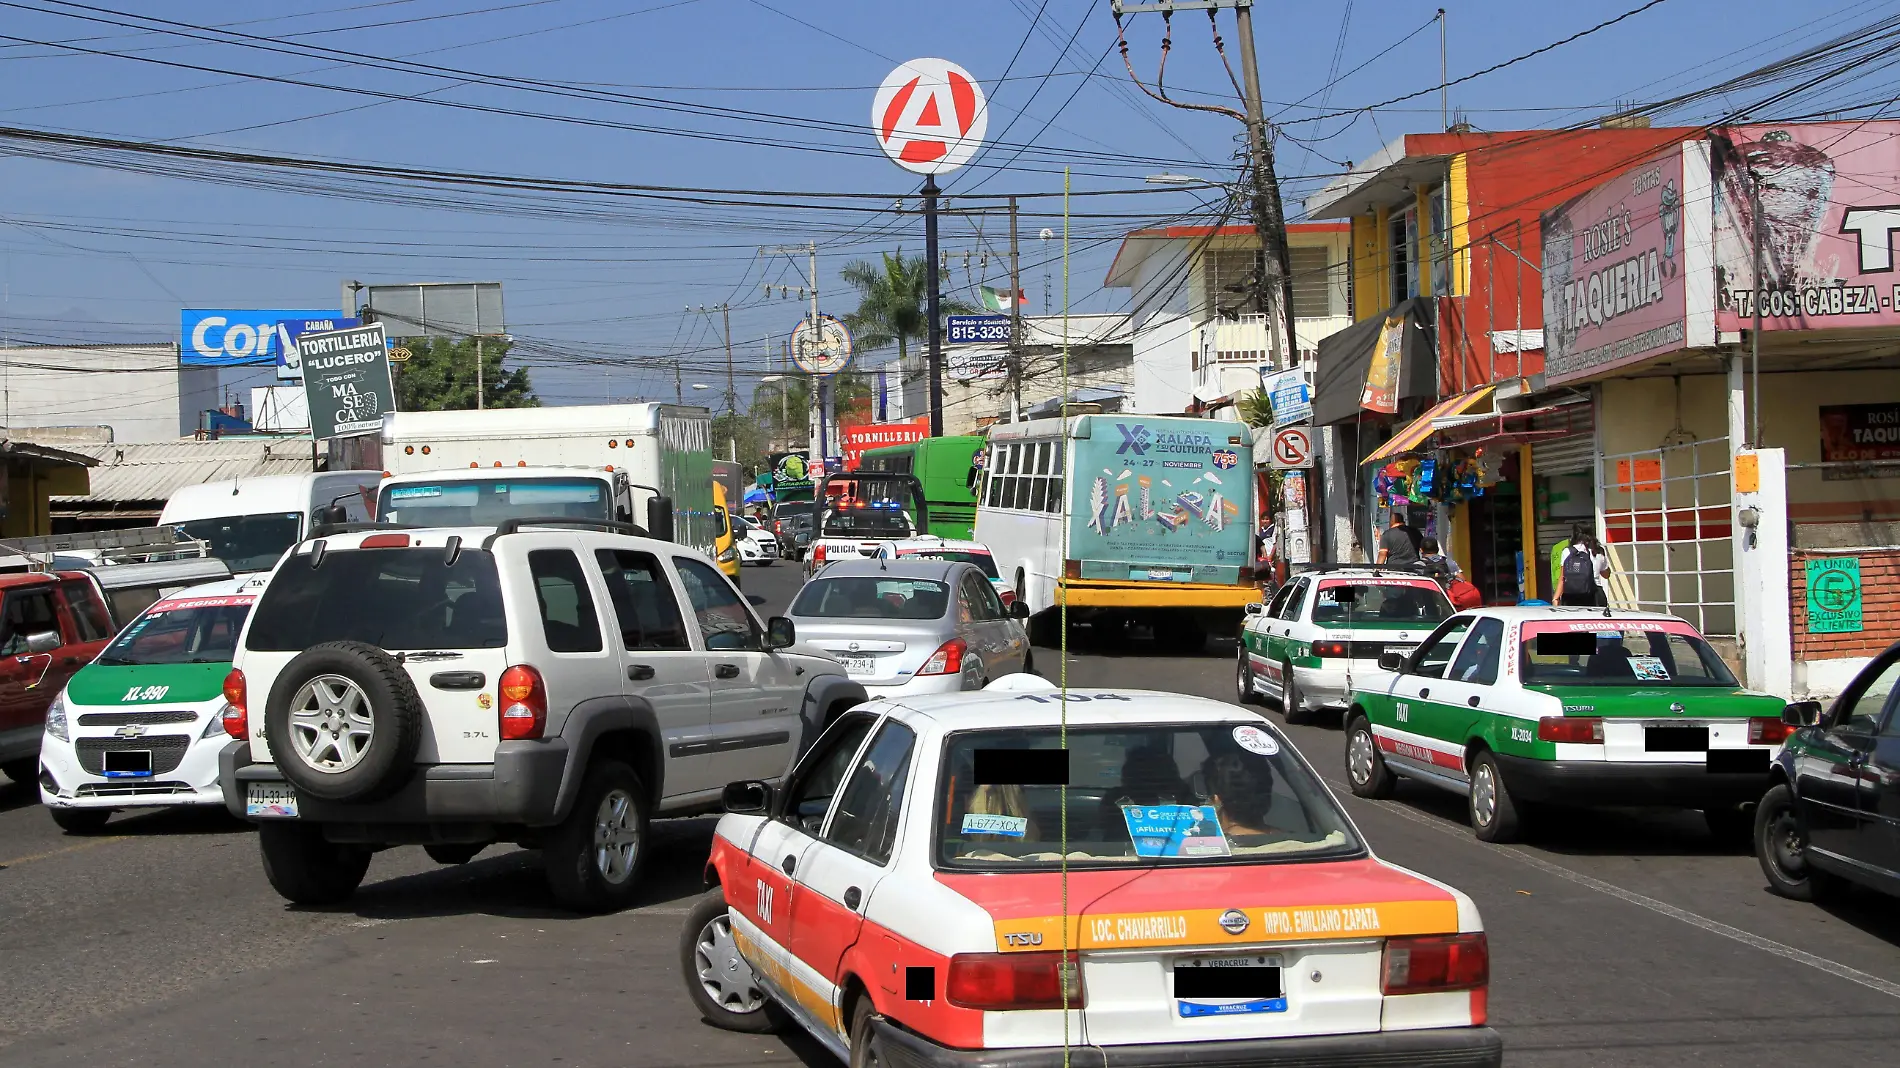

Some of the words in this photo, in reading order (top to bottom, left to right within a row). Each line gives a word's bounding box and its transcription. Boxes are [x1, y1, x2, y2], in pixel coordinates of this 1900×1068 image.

[1633, 166, 1660, 197] TORTAS
[1564, 248, 1664, 330] TAQUERIA
[1805, 284, 1880, 316] CABEZA
[305, 319, 334, 331] CABAÑA
[952, 326, 1011, 339] 815-3293
[301, 331, 382, 356] TORTILLERIA
[326, 375, 343, 383] TODO
[337, 422, 356, 432] 100%
[852, 432, 924, 444] TORNILLERIA
[1169, 446, 1212, 454] CULTURA
[1213, 453, 1238, 464] 753
[826, 545, 856, 554] POLICIA
[177, 599, 228, 609] REGION
[1808, 611, 1860, 620] EXCLUSIVO
[1617, 622, 1664, 632] XALAPA
[1814, 620, 1861, 630] CLIENTES
[122, 686, 170, 702] XL-990
[1396, 702, 1409, 723] TAXI
[1511, 727, 1532, 744] XL-2034
[967, 818, 1019, 832] A-677-XCX
[756, 878, 774, 925] TAXI
[1091, 918, 1115, 942] LOC.
[1118, 916, 1187, 941] CHAVARRILLO
[1264, 911, 1292, 935] MPIO.
[1294, 910, 1340, 934] EMILIANO
[1342, 907, 1380, 932] ZAPATA
[1004, 932, 1044, 947] TSU
[1208, 958, 1248, 968] VERACRUZ
